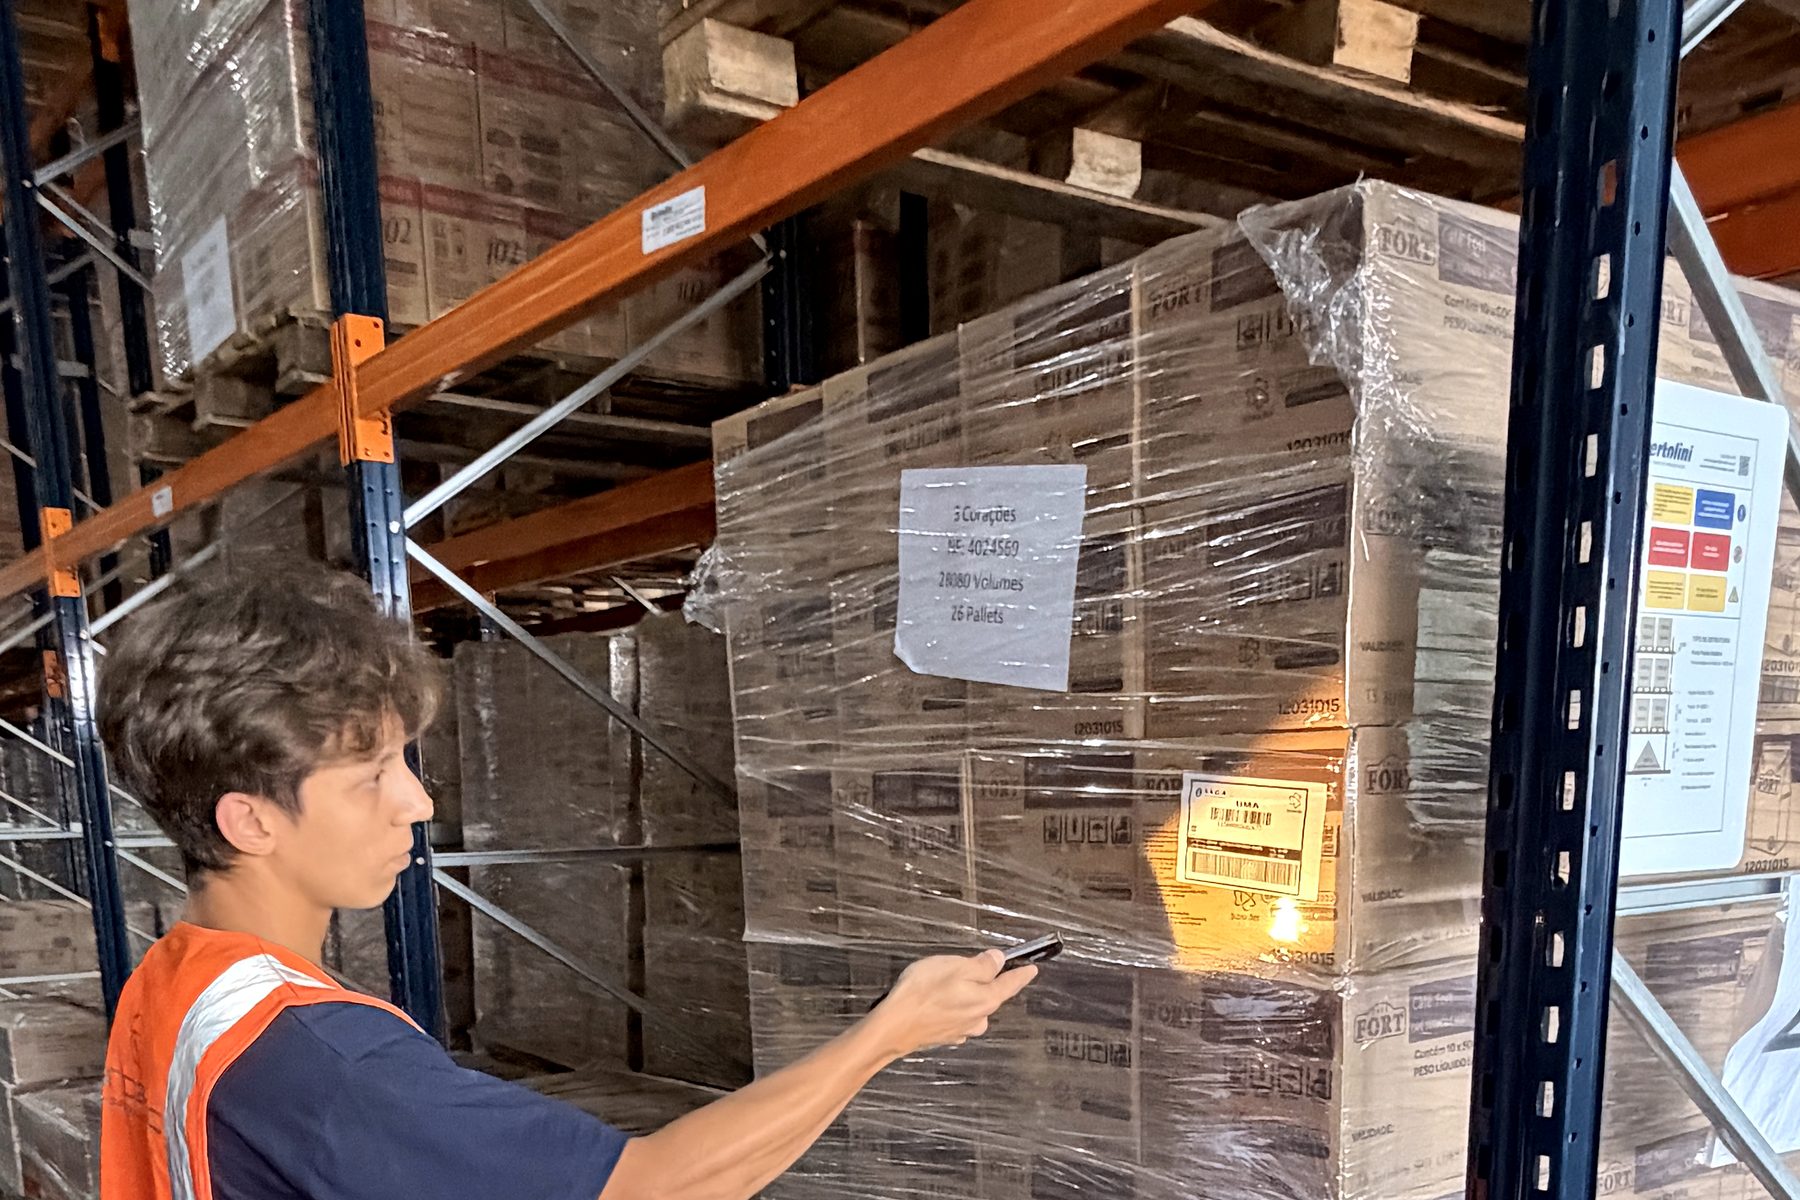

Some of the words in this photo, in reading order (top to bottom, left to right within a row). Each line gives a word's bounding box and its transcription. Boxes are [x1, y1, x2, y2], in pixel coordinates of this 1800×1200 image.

[1649, 441, 1694, 463] ertolini
[973, 572, 1025, 592] Volumes
[966, 606, 1004, 625] Pallets
[1074, 719, 1124, 736] 12031015
[1745, 857, 1789, 873] 12031015
[1356, 1012, 1404, 1040] FORT
[1413, 1063, 1435, 1077] PESO
